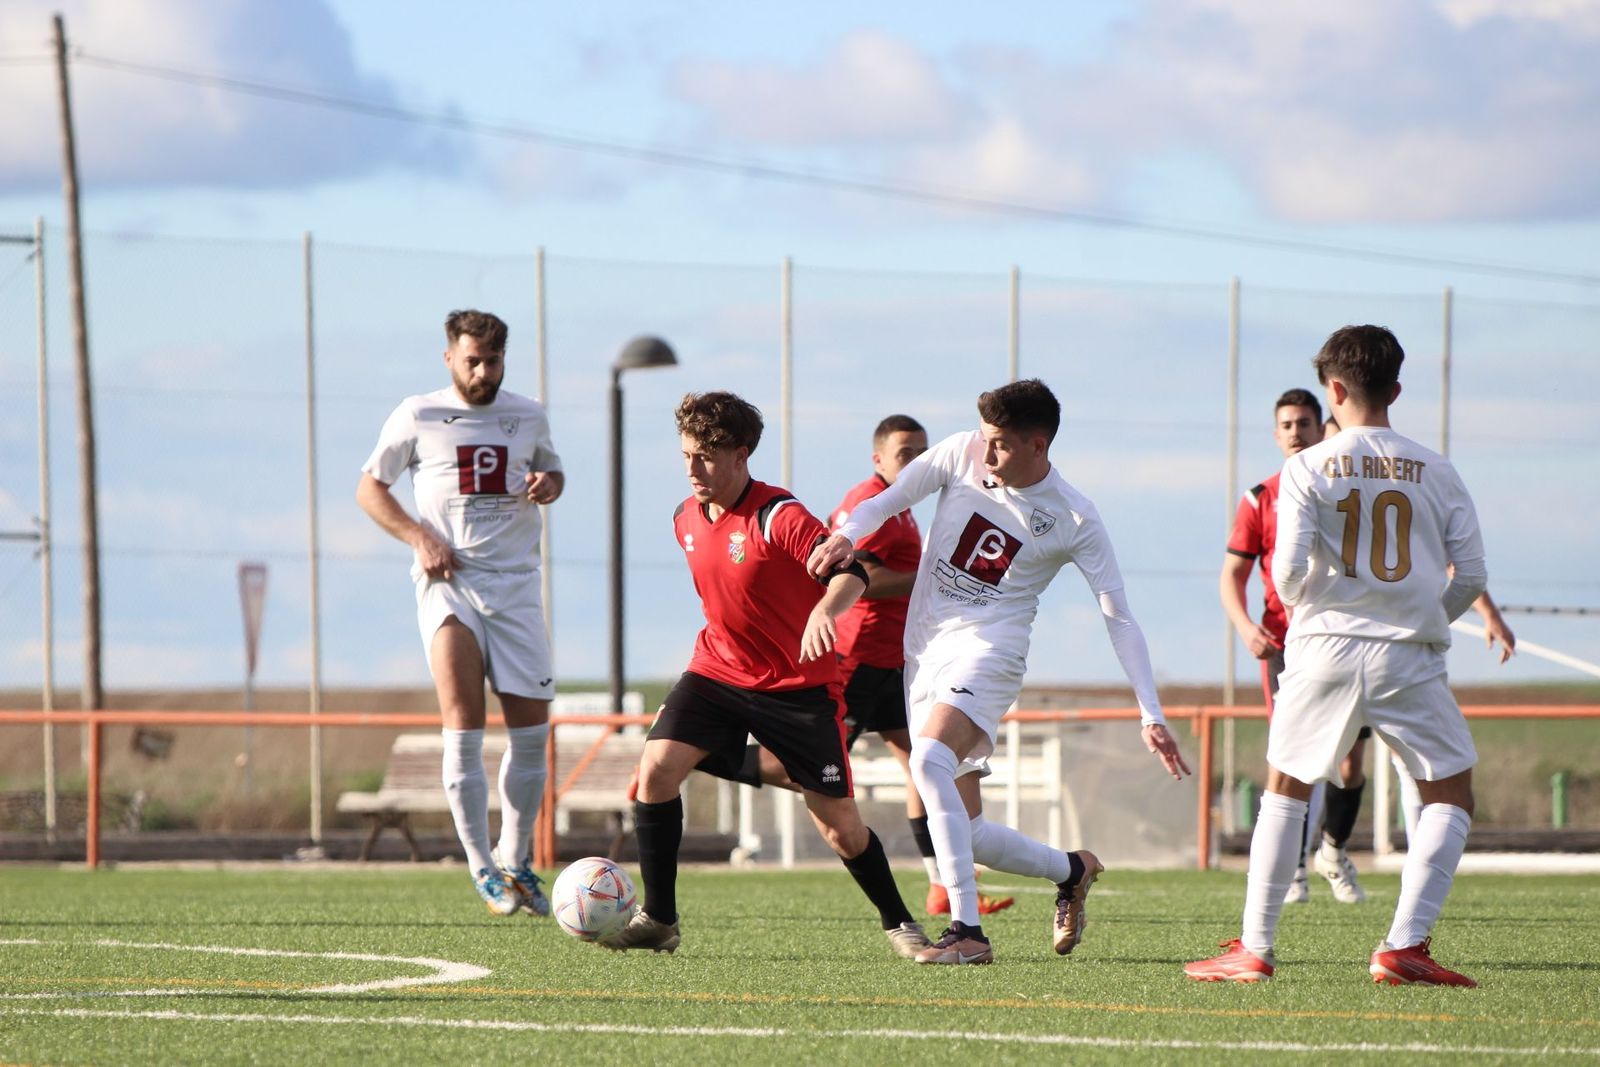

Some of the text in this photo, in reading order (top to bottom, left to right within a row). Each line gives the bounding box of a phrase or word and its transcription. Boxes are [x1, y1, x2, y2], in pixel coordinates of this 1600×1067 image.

[1325, 455, 1426, 484] C.D. RIBERT
[1336, 488, 1413, 583] 10
